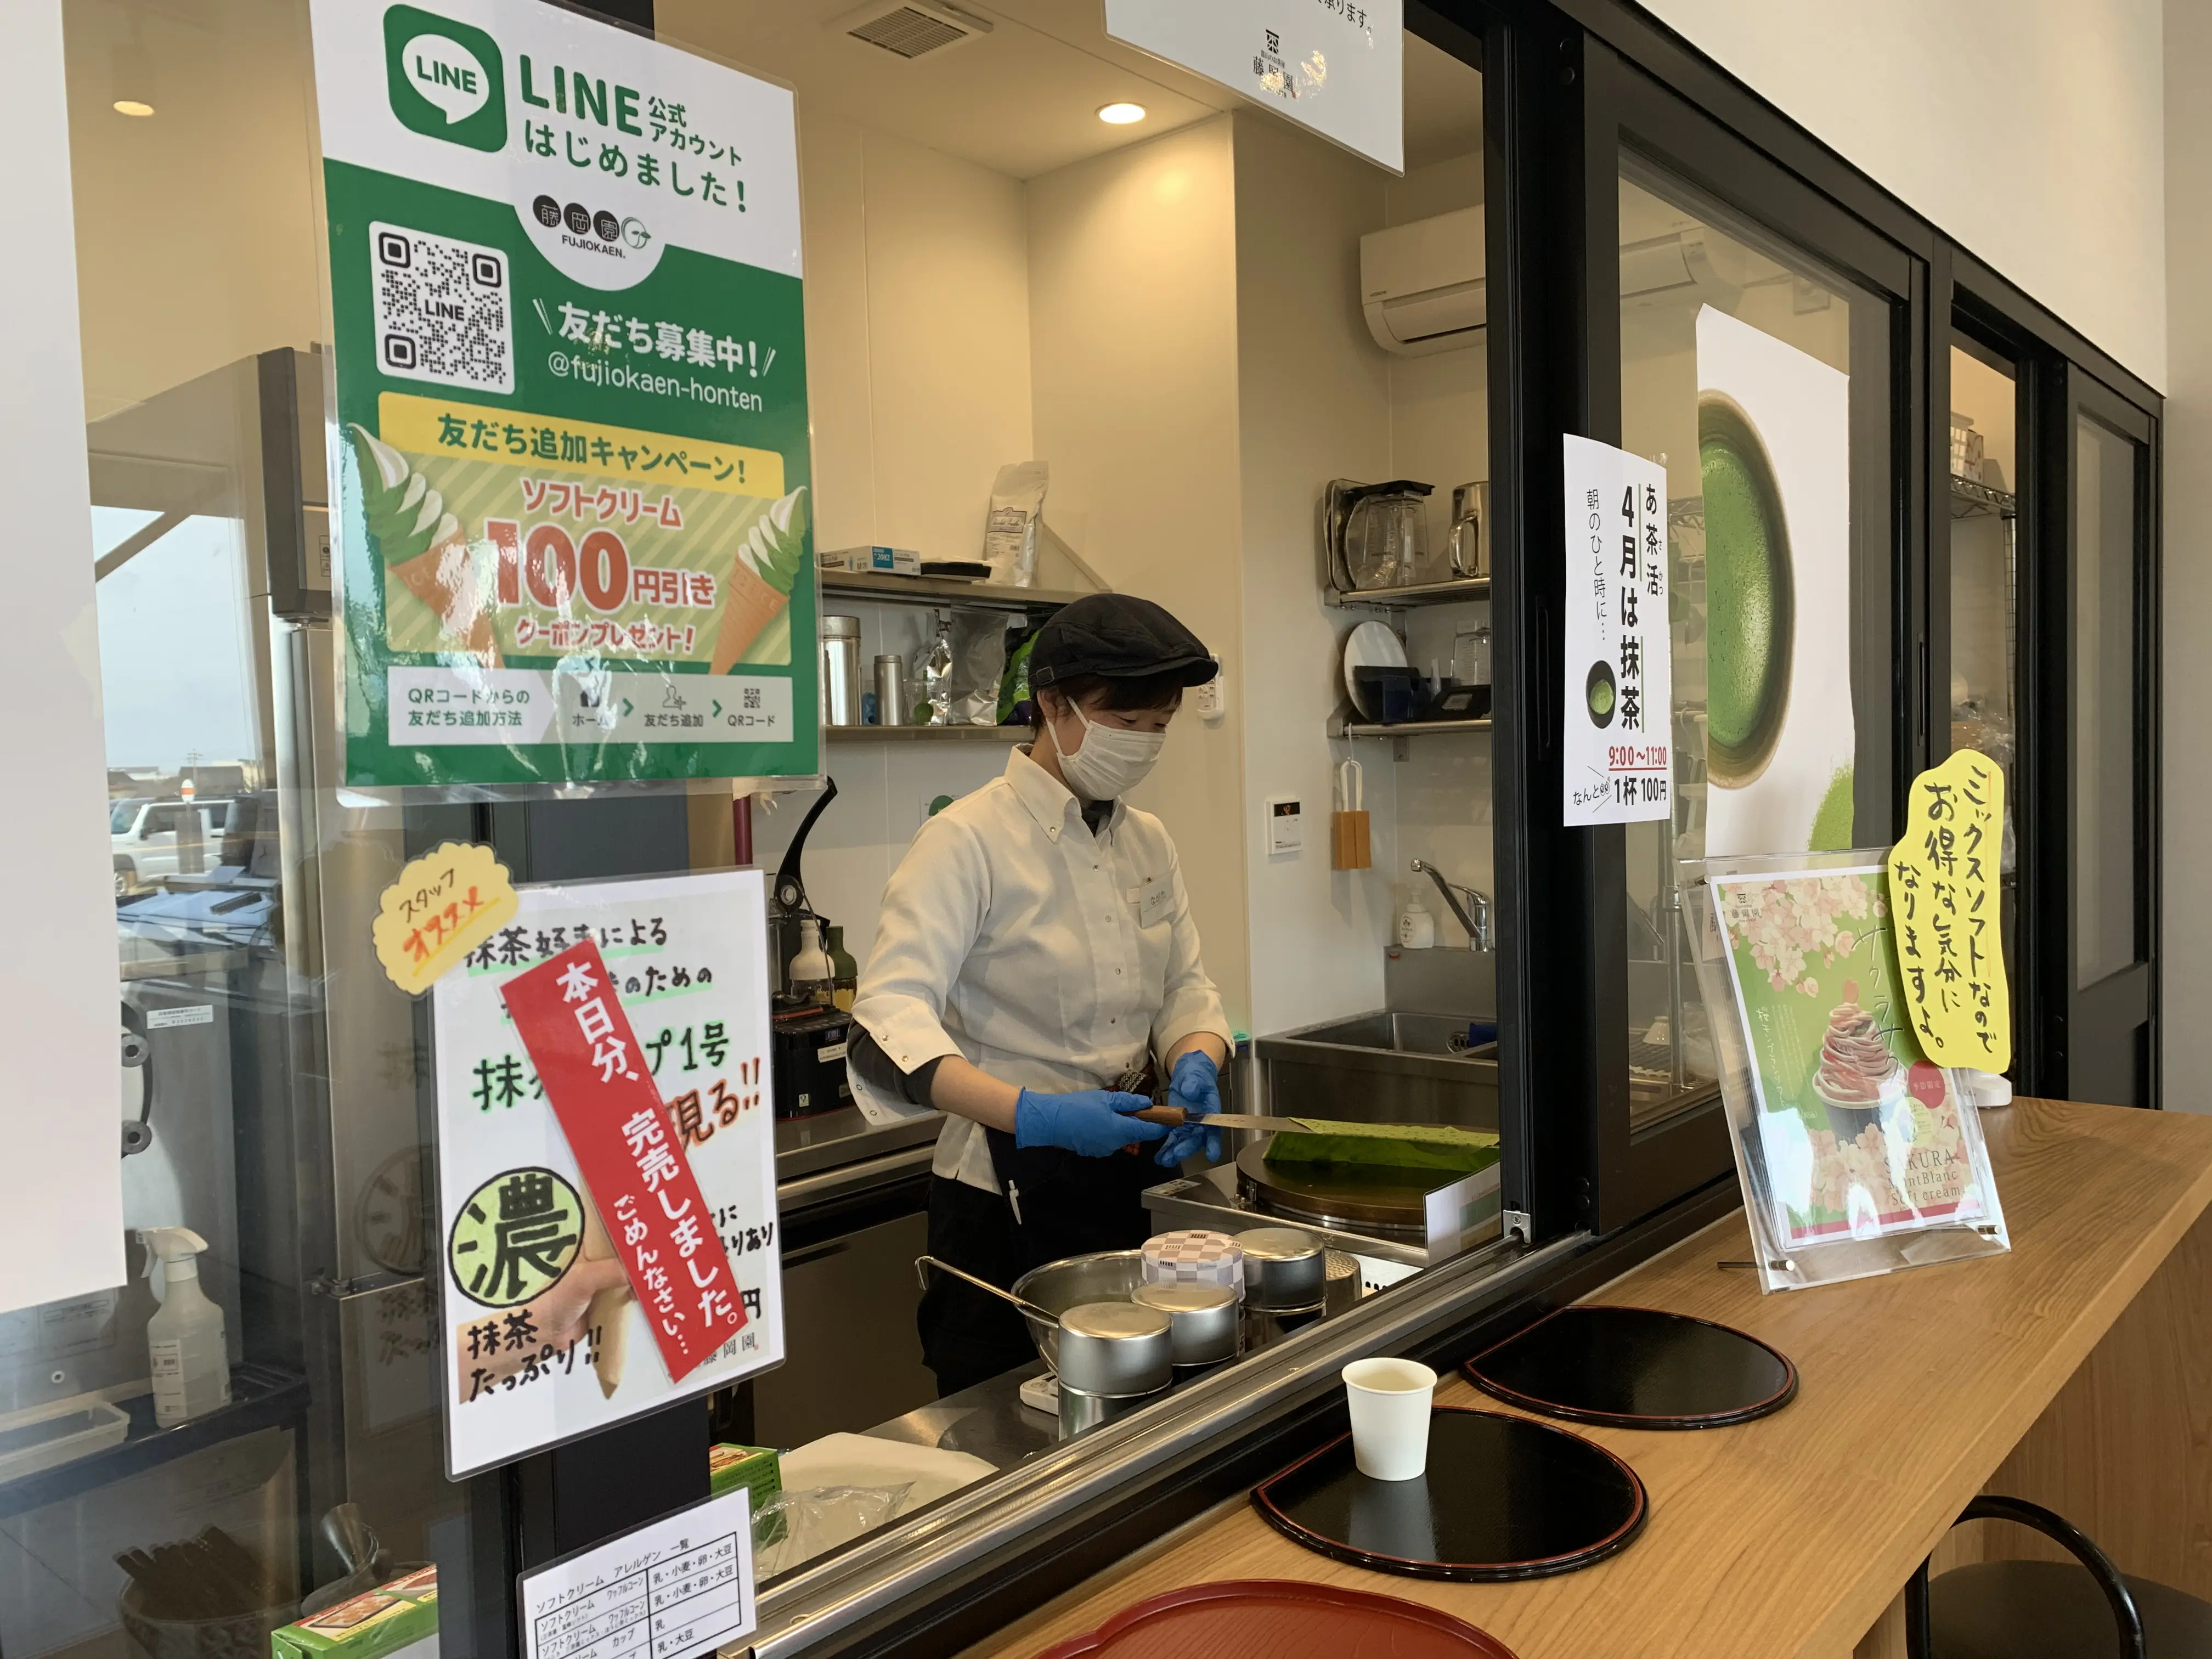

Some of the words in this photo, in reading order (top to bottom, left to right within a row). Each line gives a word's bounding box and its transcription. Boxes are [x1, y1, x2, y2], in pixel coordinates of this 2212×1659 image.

[416, 55, 478, 96] LINE
[520, 54, 643, 137] LINE
[649, 96, 687, 128] 公式
[525, 120, 747, 213] はじめました!
[652, 123, 742, 167] アカウント
[561, 234, 627, 259] FUJIOKAEN.
[425, 299, 465, 323] LINE
[558, 301, 759, 378] 友だち募集中!
[549, 352, 763, 413] @fujiokaen-honten
[438, 412, 746, 484] 友だち追加キャンペーン!
[521, 478, 683, 528] ソフトクリーム
[1645, 483, 1658, 596] あ茶活
[1619, 485, 1640, 730] 4月は抹茶
[516, 618, 695, 652] クーポンプレゼント!
[408, 687, 531, 705] QRコードからの
[408, 710, 522, 728] 友だち追加方法
[644, 713, 704, 728] 友だち追加
[727, 714, 775, 727] QRコード
[1573, 783, 1600, 806] なんと
[1641, 777, 1667, 802] 100円
[1923, 782, 1962, 1013] お得な気分に
[1962, 765, 1997, 1054] ミックスソフトなので
[403, 885, 483, 963] オススメ
[1894, 861, 1945, 1049] なりますよ。
[1923, 1186, 1961, 1201] cream
[457, 1173, 578, 1300] 濃
[621, 1107, 738, 1328] 完売しました。
[467, 1309, 539, 1360] 抹茶
[537, 1575, 605, 1613] ソフトクリーム
[614, 1551, 661, 1578] アレルゲン
[670, 1538, 690, 1551] 一覧
[541, 1599, 595, 1632] ソフトクリーム
[612, 1628, 635, 1648] カップ
[542, 1623, 596, 1657] ソフトクリーム
